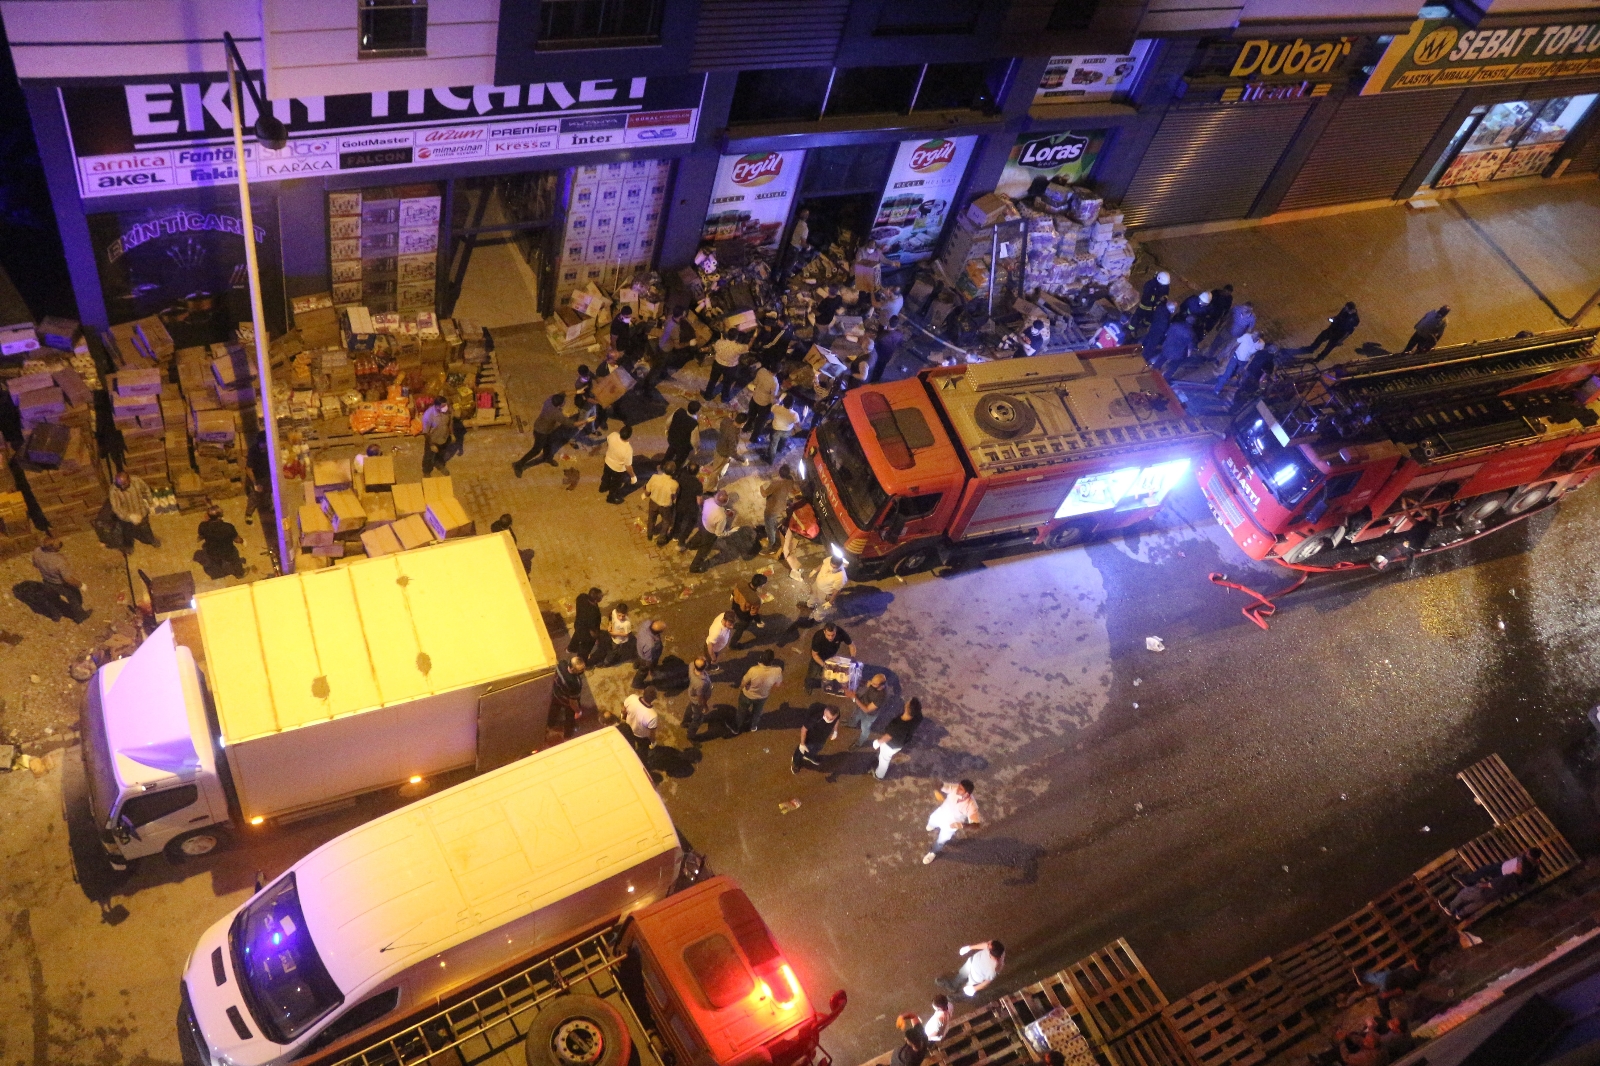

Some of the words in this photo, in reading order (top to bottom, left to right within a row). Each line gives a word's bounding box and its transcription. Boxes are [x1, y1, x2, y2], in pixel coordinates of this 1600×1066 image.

[1449, 27, 1541, 62] SEBAT
[1229, 37, 1351, 77] Dubai
[341, 136, 410, 149] GoldMaster
[424, 129, 484, 142] arzum
[347, 151, 406, 166] FALCON
[910, 142, 956, 168] Ergül
[1021, 143, 1083, 163] Loras
[92, 155, 165, 173] arnica
[266, 160, 333, 175] KARACA
[732, 154, 782, 181] Ergül
[161, 211, 266, 243] TİCART
